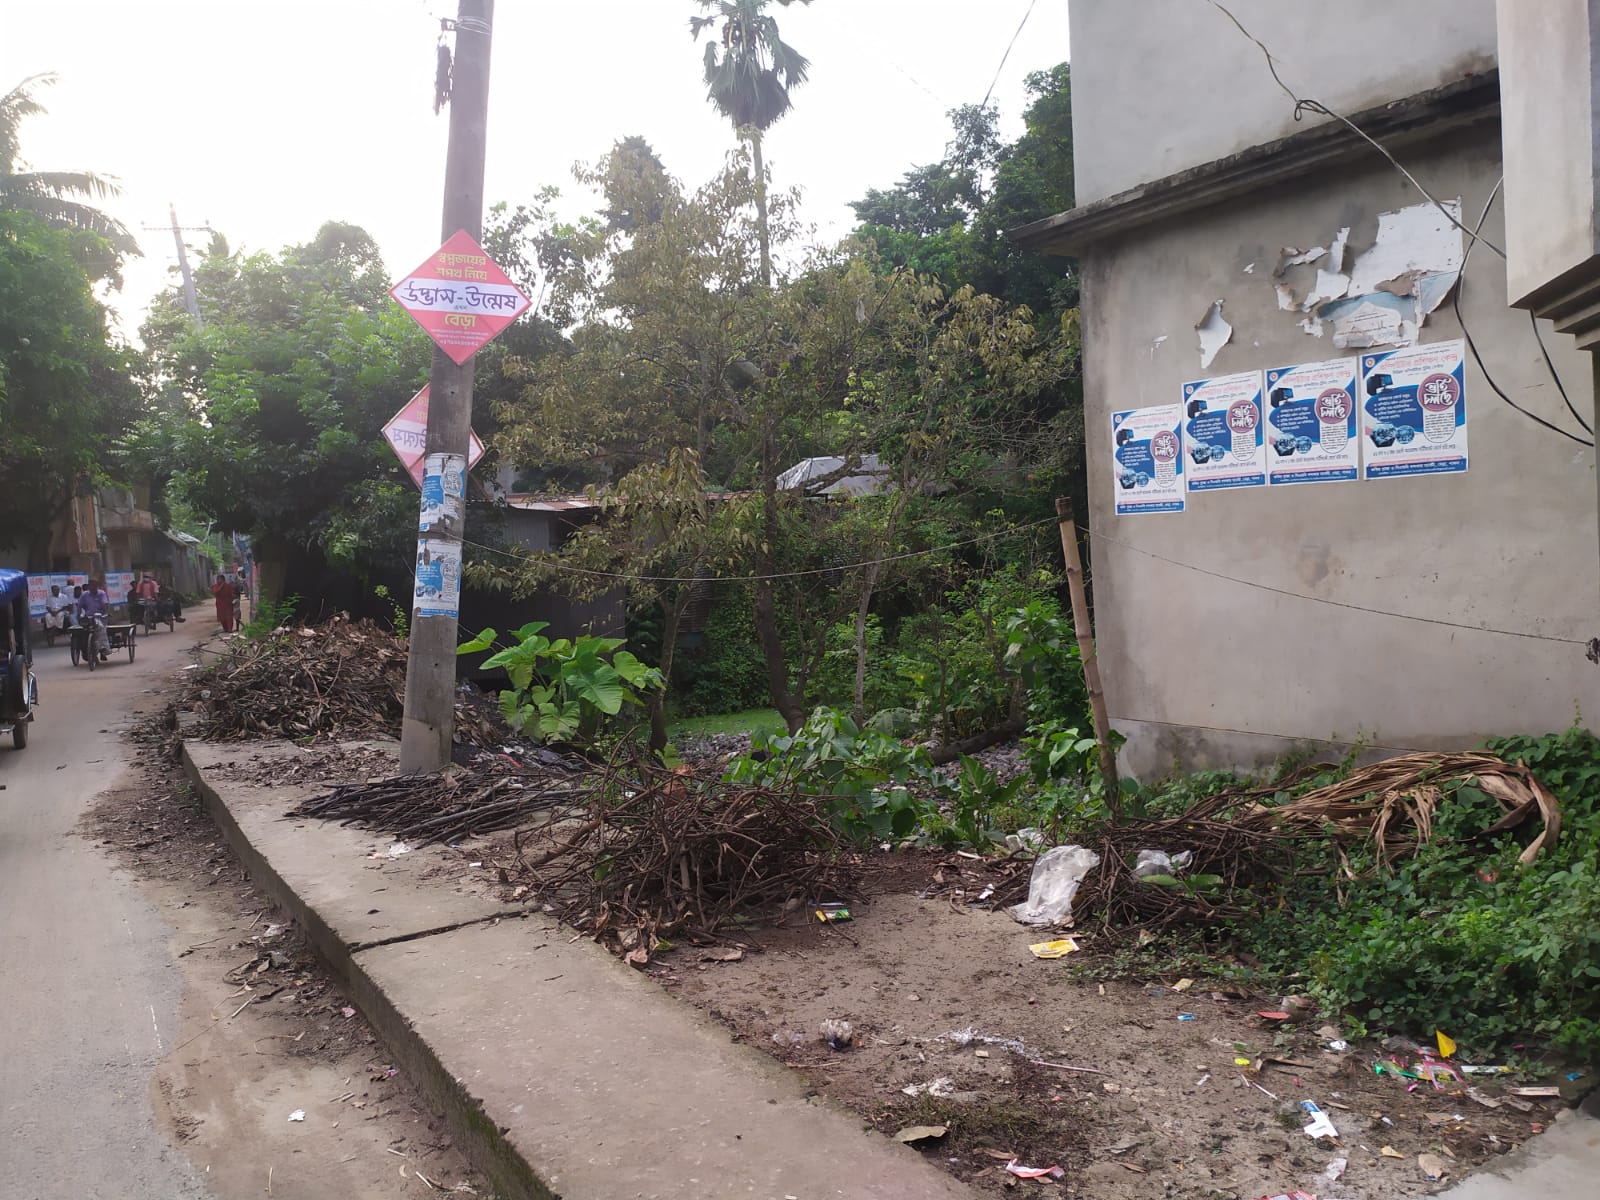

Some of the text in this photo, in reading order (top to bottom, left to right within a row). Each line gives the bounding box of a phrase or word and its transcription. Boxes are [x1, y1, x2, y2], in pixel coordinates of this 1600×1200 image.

[435, 266, 487, 280] শপথ নিয়ে
[444, 314, 478, 330] বেড়া
[1424, 378, 1452, 394] ভর্তি
[1424, 390, 1456, 406] চলছে
